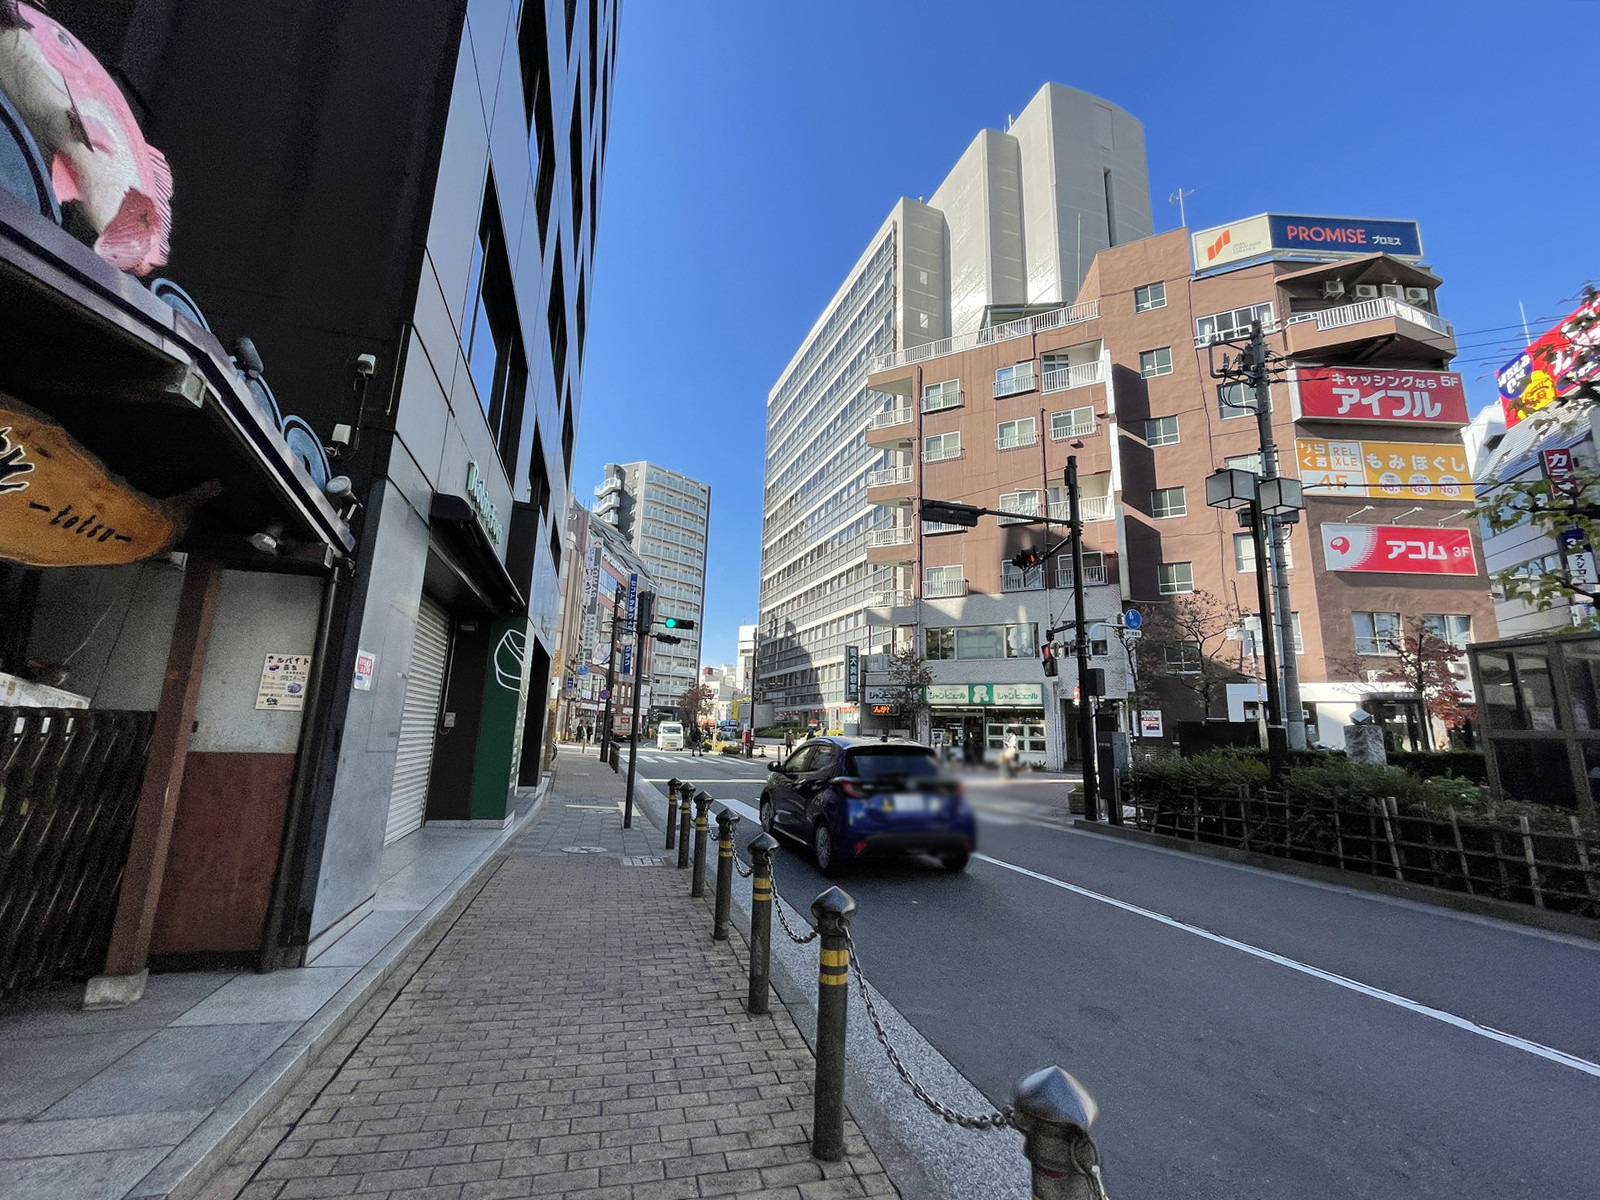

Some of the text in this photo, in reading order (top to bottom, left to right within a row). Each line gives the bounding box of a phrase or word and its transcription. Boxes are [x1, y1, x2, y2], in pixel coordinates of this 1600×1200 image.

[1287, 225, 1367, 244] PROMISE
[1372, 234, 1402, 246] プロミス
[1331, 372, 1459, 389] キャッシングなら 5F
[1332, 387, 1442, 418] アイフル
[1367, 453, 1466, 473] もみほぐし
[1319, 474, 1348, 491] 4F
[1386, 540, 1470, 560] アコム 3F
